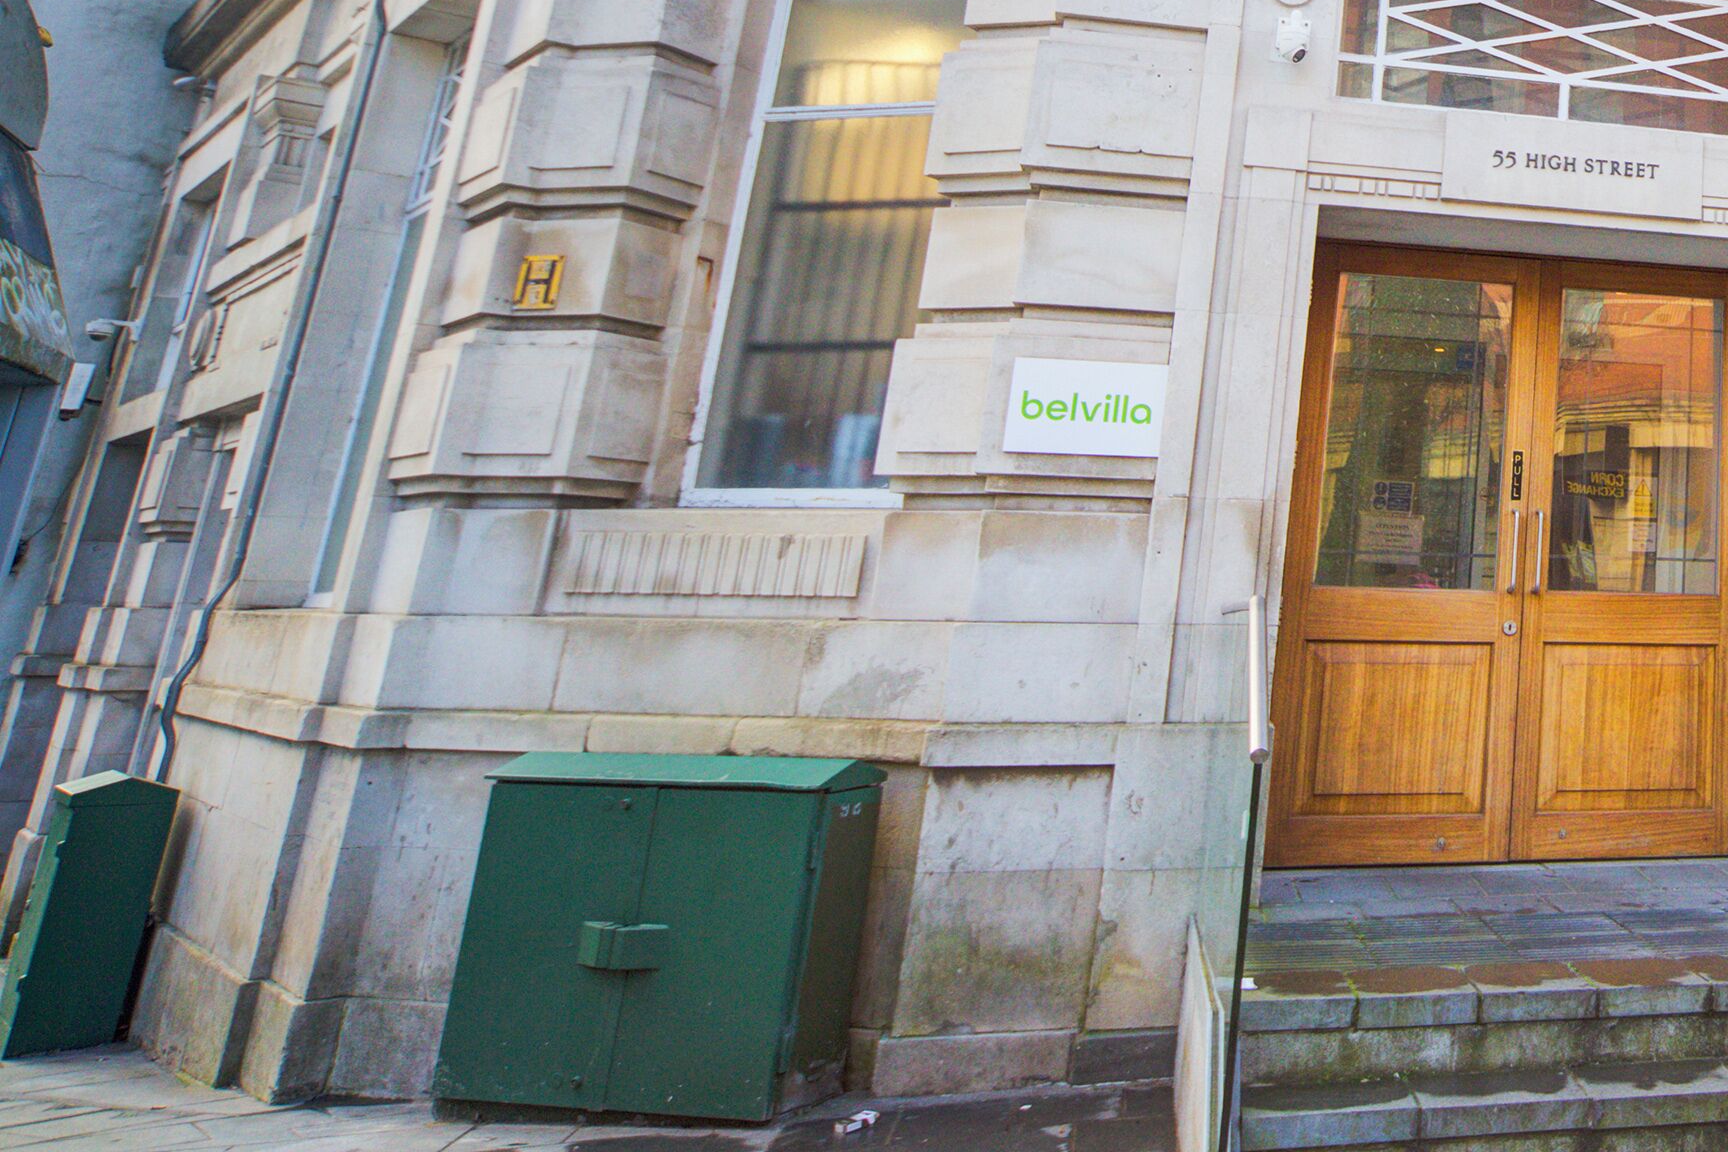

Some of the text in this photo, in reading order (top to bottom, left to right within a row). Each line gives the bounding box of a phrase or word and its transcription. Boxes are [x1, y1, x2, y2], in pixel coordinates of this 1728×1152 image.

[1492, 150, 1660, 179] 55 HIGH STREET
[1021, 390, 1152, 425] belvilla
[1513, 454, 1521, 497] PULL
